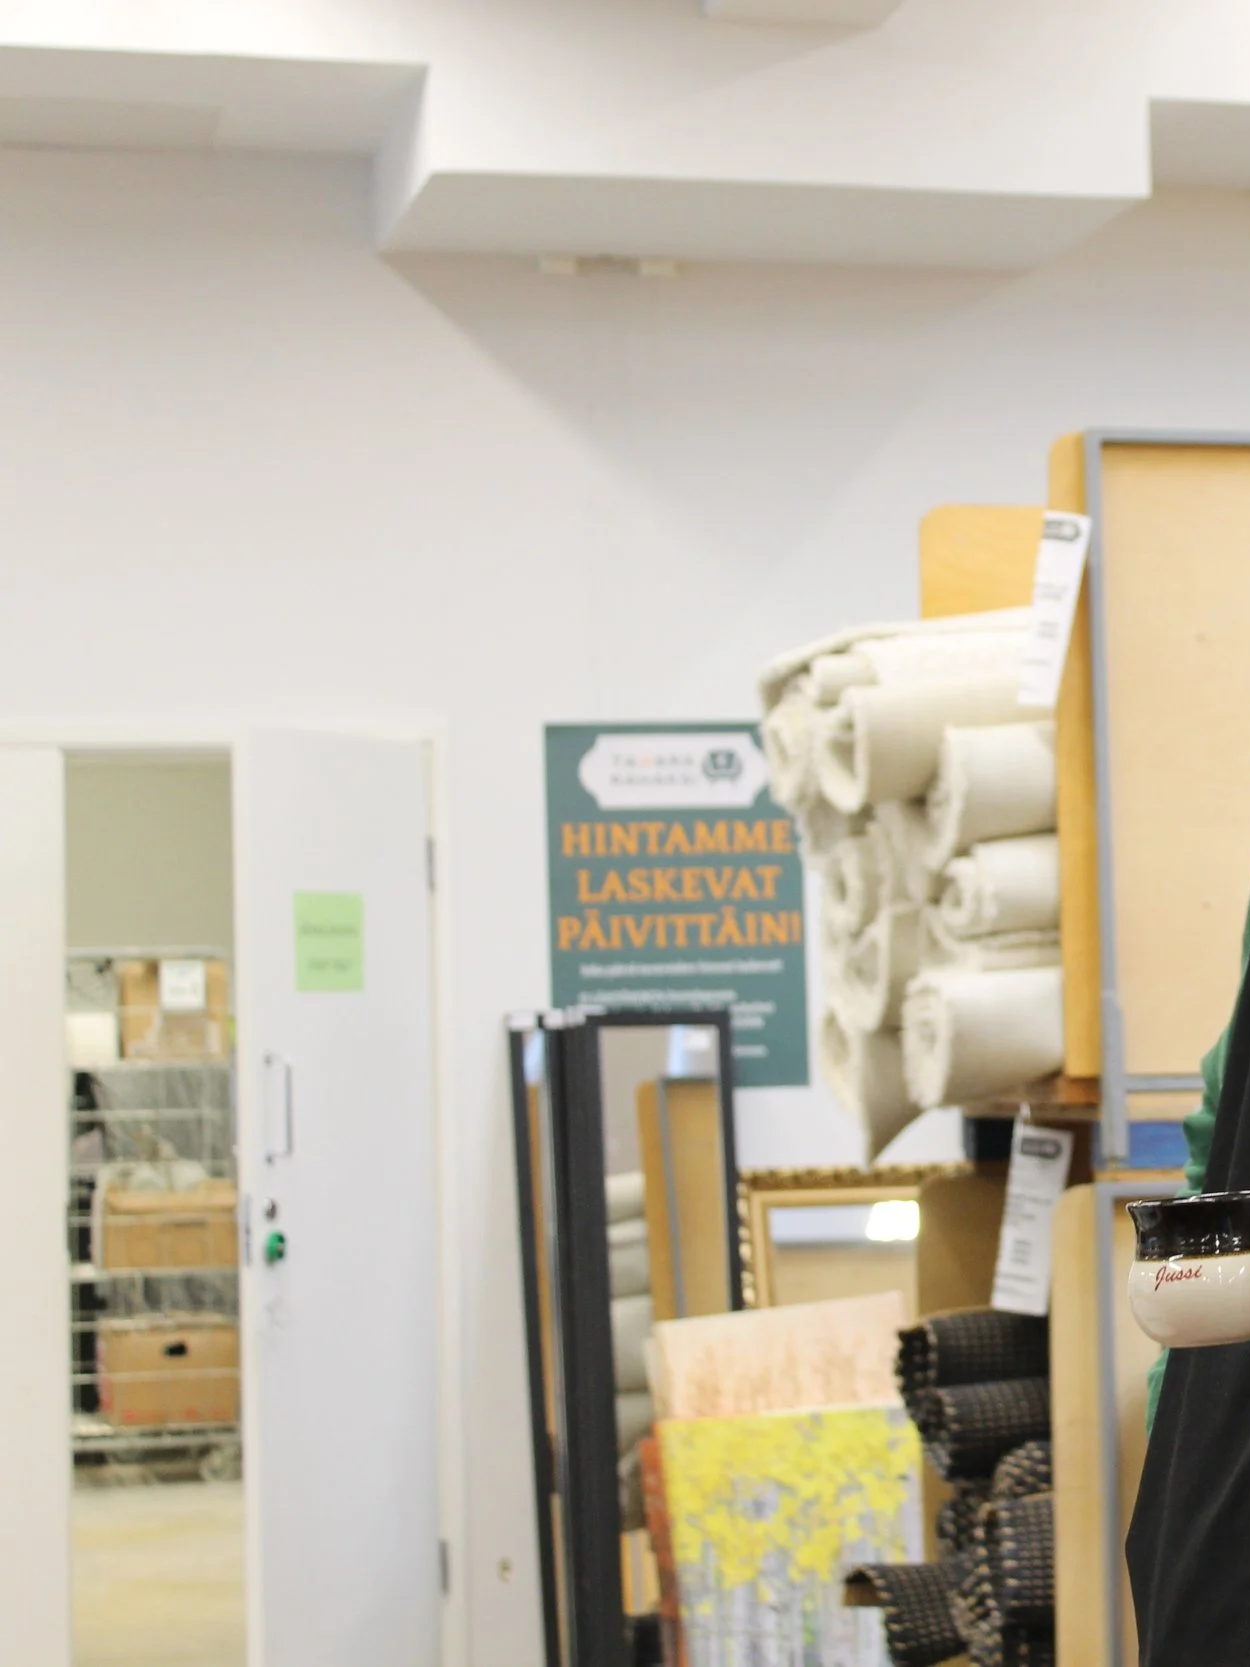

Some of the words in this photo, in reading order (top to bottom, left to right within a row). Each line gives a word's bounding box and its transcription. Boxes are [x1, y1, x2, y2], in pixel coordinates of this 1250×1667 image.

[561, 819, 796, 858] HINTAMME
[577, 865, 783, 904] LASKEVAT
[556, 906, 804, 951] PÄIVITTÄIN!
[1154, 1264, 1203, 1292] Jussi
